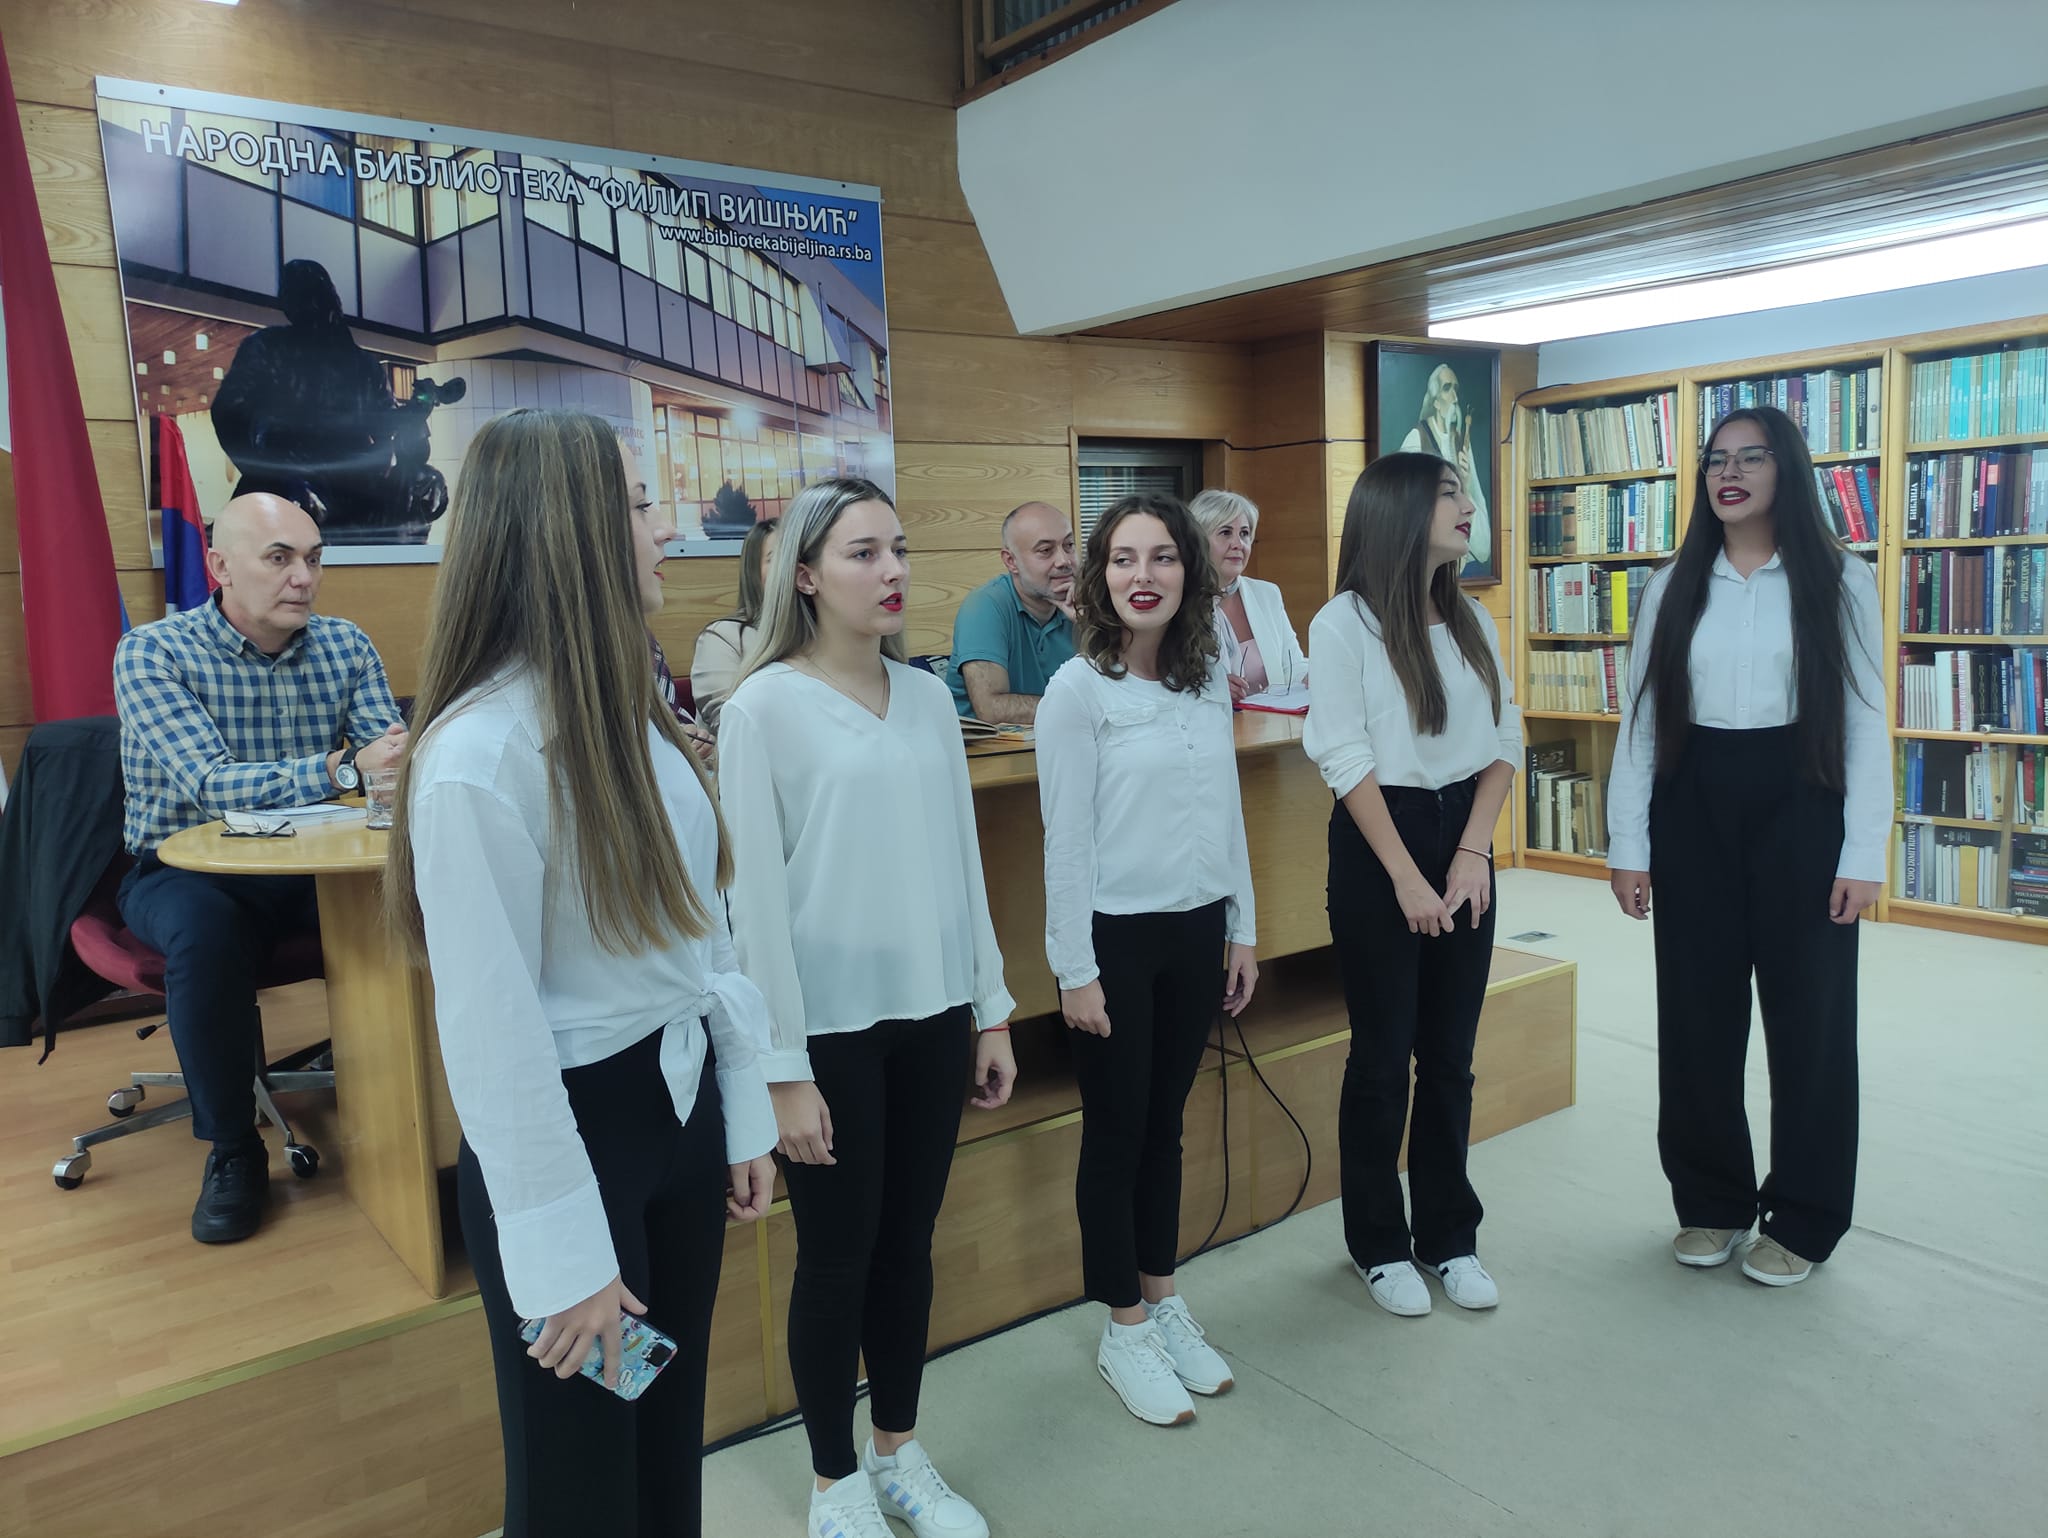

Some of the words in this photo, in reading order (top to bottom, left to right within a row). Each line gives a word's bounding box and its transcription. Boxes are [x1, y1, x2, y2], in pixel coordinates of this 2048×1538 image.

[140, 119, 345, 178] НАРОДНА
[353, 147, 584, 206] БИБЛИОТЕКА
[660, 225, 873, 262] www.bibliotekabijeljina.rs.ba
